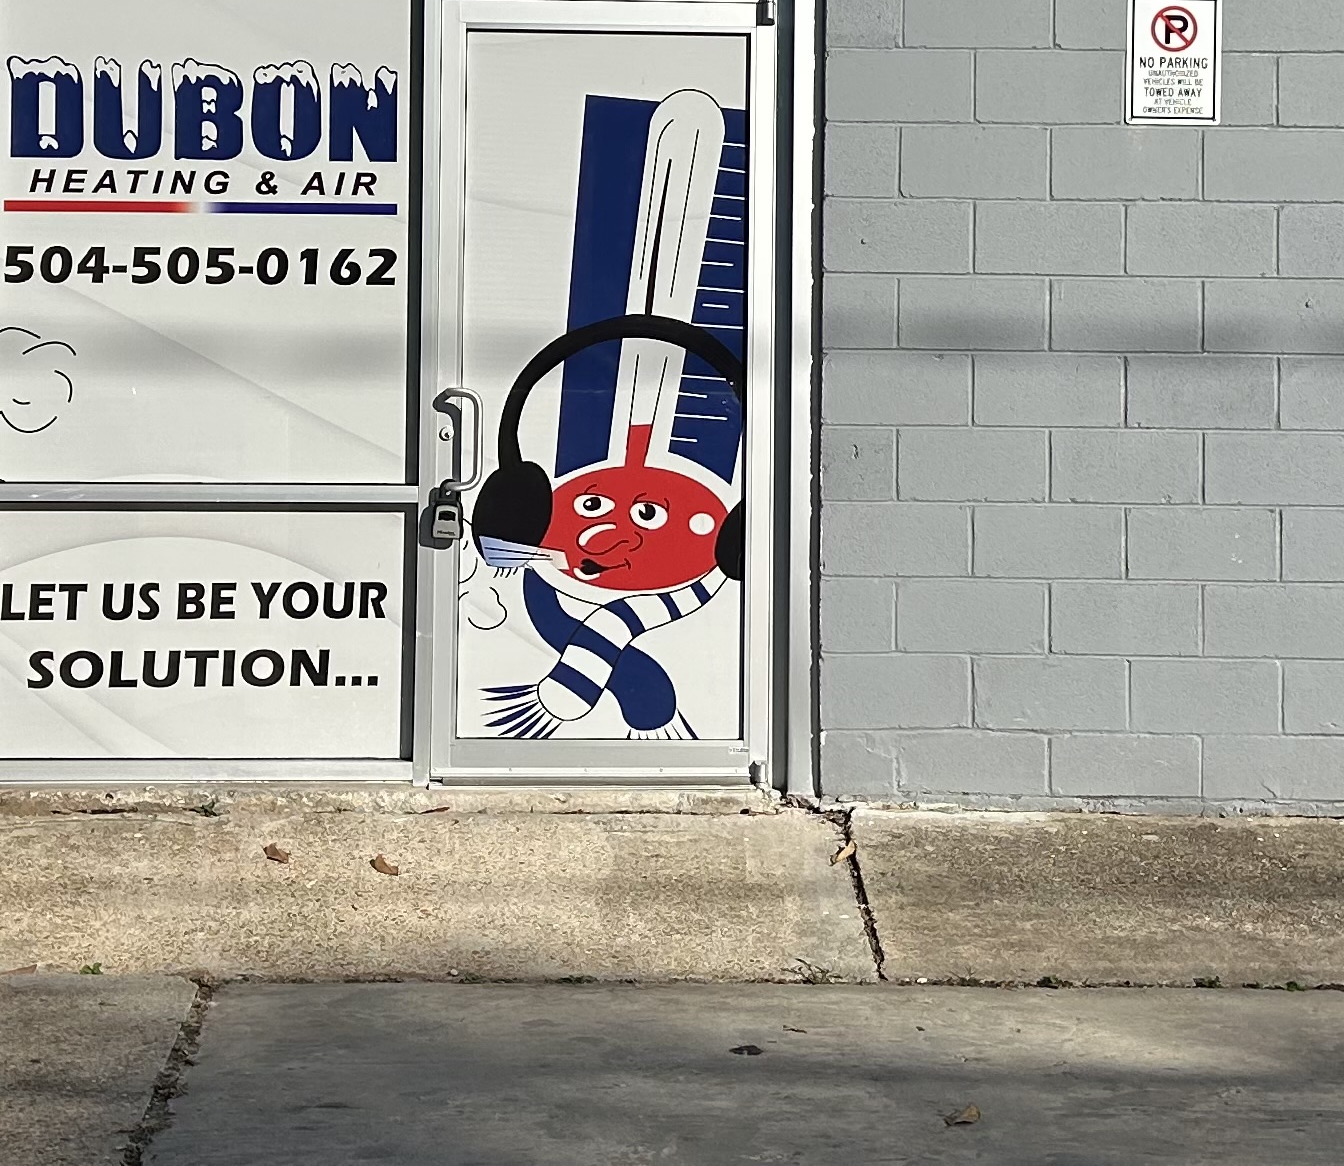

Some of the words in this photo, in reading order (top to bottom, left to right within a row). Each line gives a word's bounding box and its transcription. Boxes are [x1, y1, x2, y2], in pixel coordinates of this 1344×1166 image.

[1139, 56, 1155, 69] NO
[1159, 56, 1209, 69] PARKING
[7, 56, 398, 162] DUBON
[1144, 86, 1175, 97] TOWED
[1177, 87, 1203, 98] AWAY
[29, 169, 231, 195] HEATING
[255, 170, 278, 196] &
[300, 171, 378, 196] AIR
[3, 245, 398, 286] 504-505-0162
[0, 583, 89, 621] LET
[102, 582, 160, 621] US
[176, 582, 238, 620] BE
[250, 581, 387, 620] YOUR
[26, 649, 379, 689] SOLUTION...
